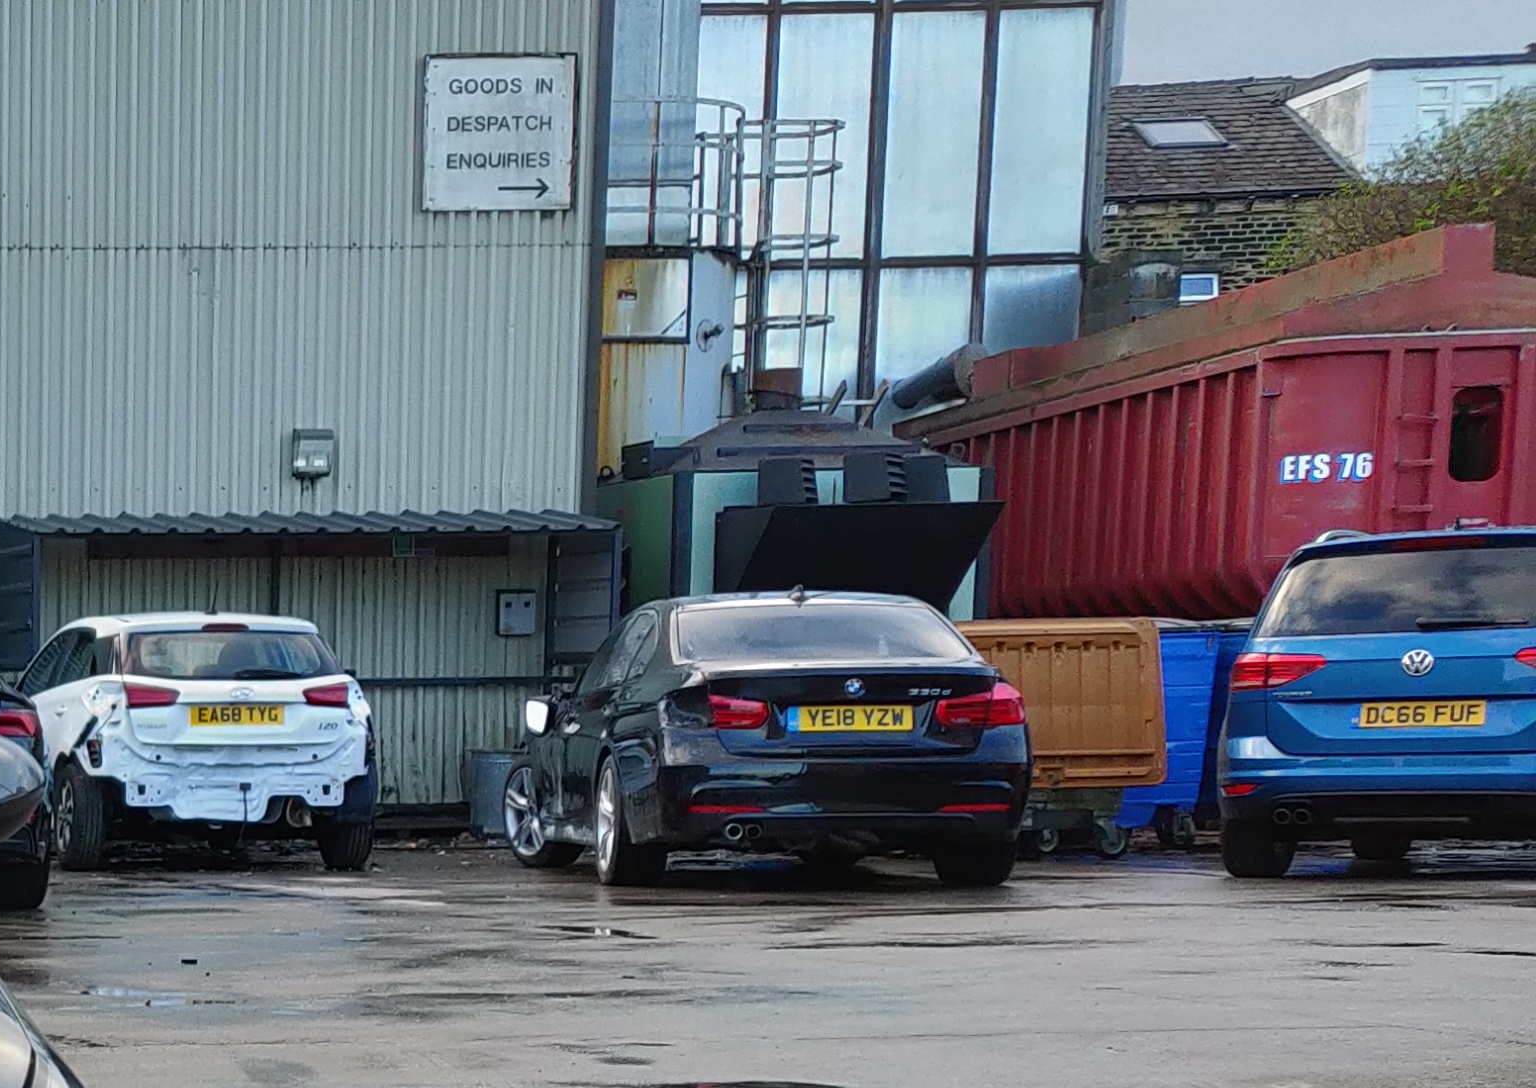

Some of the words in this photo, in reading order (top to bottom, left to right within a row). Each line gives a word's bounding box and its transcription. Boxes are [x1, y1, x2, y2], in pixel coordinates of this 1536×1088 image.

[448, 77, 523, 95] GOODS
[535, 77, 554, 95] IN
[446, 115, 553, 132] DESPATCH
[446, 151, 551, 171] ENQUIRIES
[1279, 453, 1331, 484] EFS
[1335, 452, 1374, 482] 76
[197, 707, 242, 723] EA68
[247, 706, 279, 723] TYG
[807, 709, 856, 727] YE18
[861, 708, 905, 727] YZW
[1365, 706, 1427, 725] DC66
[1433, 703, 1482, 723] FUF
